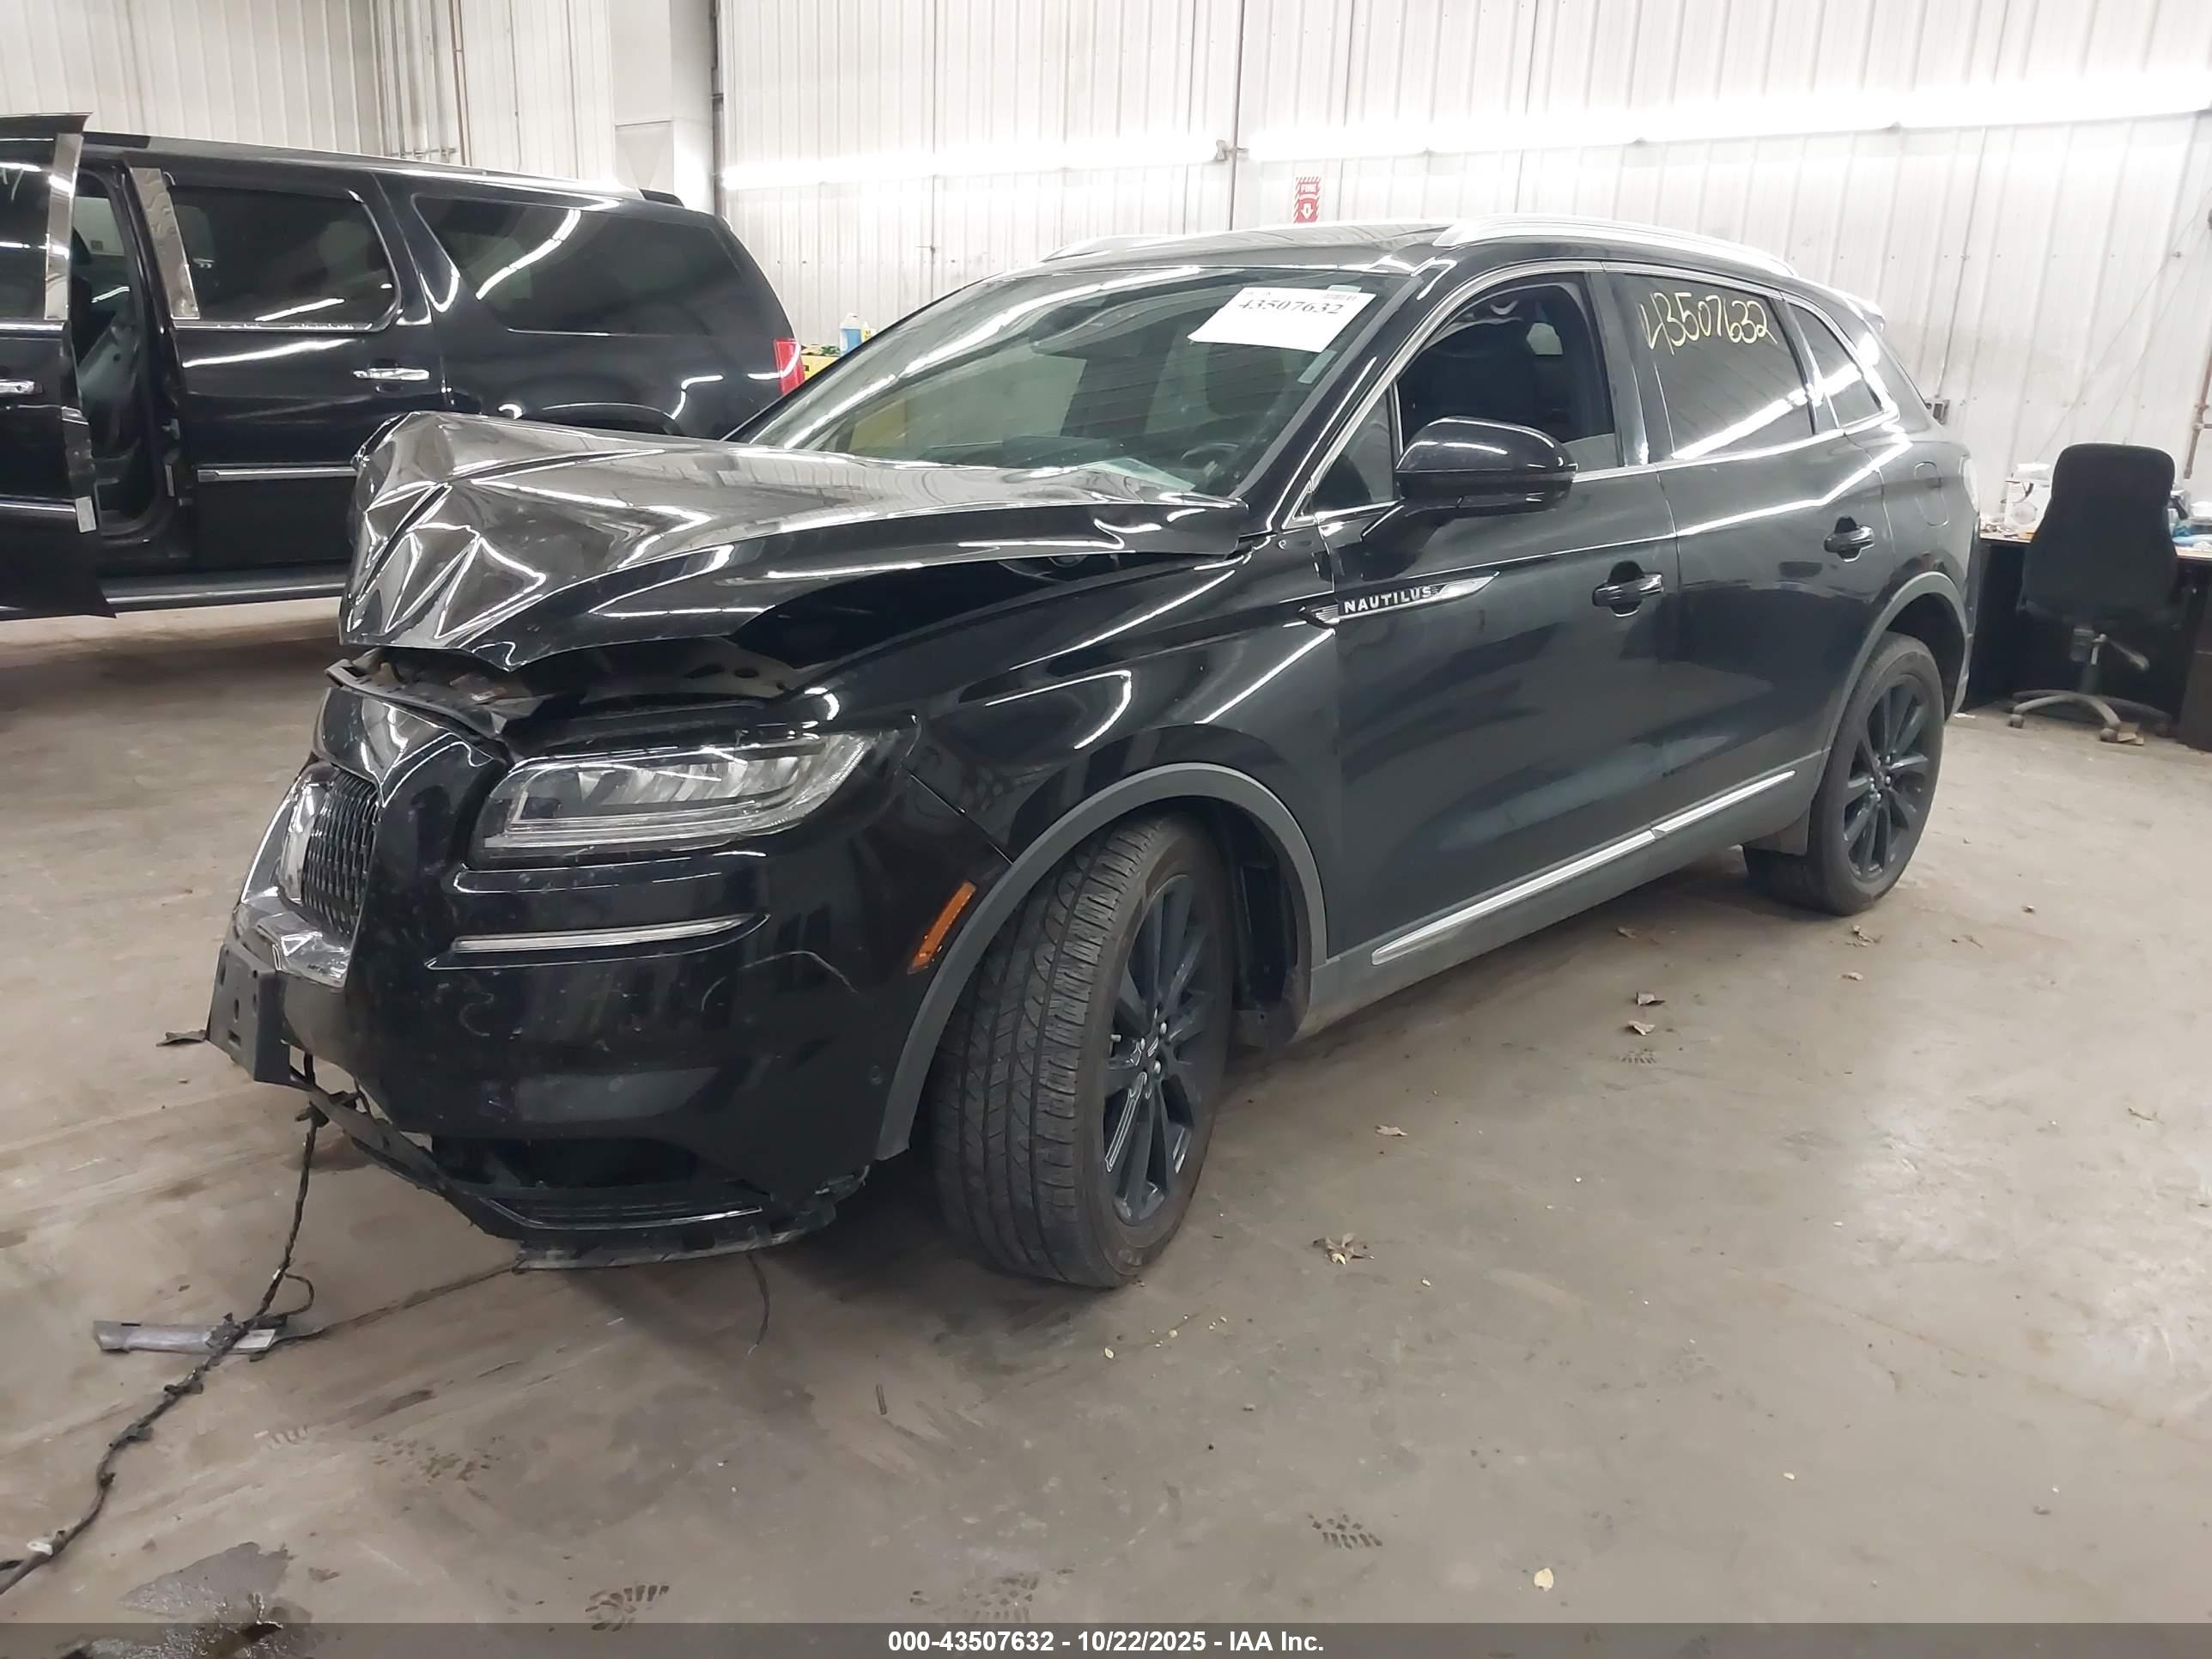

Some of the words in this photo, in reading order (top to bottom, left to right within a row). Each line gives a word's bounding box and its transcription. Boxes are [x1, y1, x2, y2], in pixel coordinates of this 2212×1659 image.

[1300, 183, 1317, 193] FIRE
[1239, 299, 1344, 314] 43507632
[1638, 292, 1778, 356] 43507632
[1344, 586, 1432, 614] NAUTILUS
